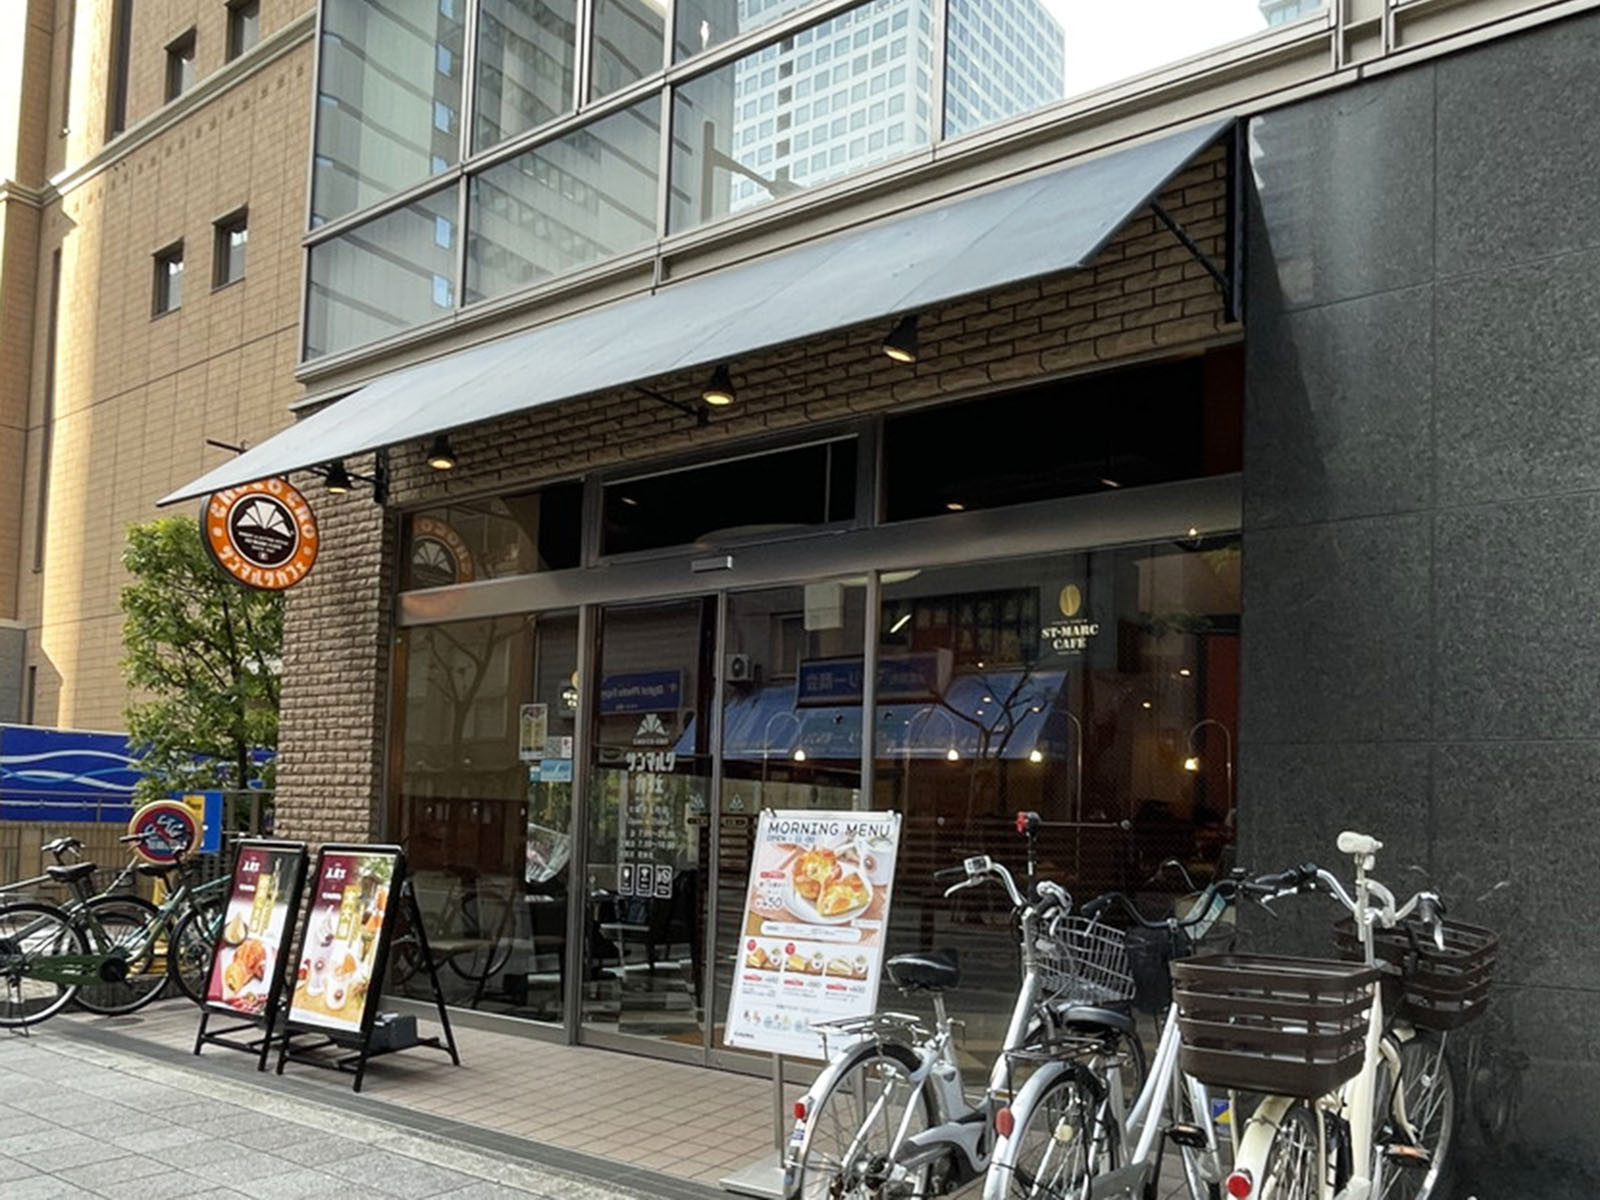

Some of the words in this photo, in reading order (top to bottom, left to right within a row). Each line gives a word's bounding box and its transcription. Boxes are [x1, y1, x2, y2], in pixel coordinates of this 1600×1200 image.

[626, 752, 676, 772] サンマルク
[635, 774, 664, 794] カフェ
[768, 821, 839, 836] MORNING
[845, 823, 891, 839] MENU
